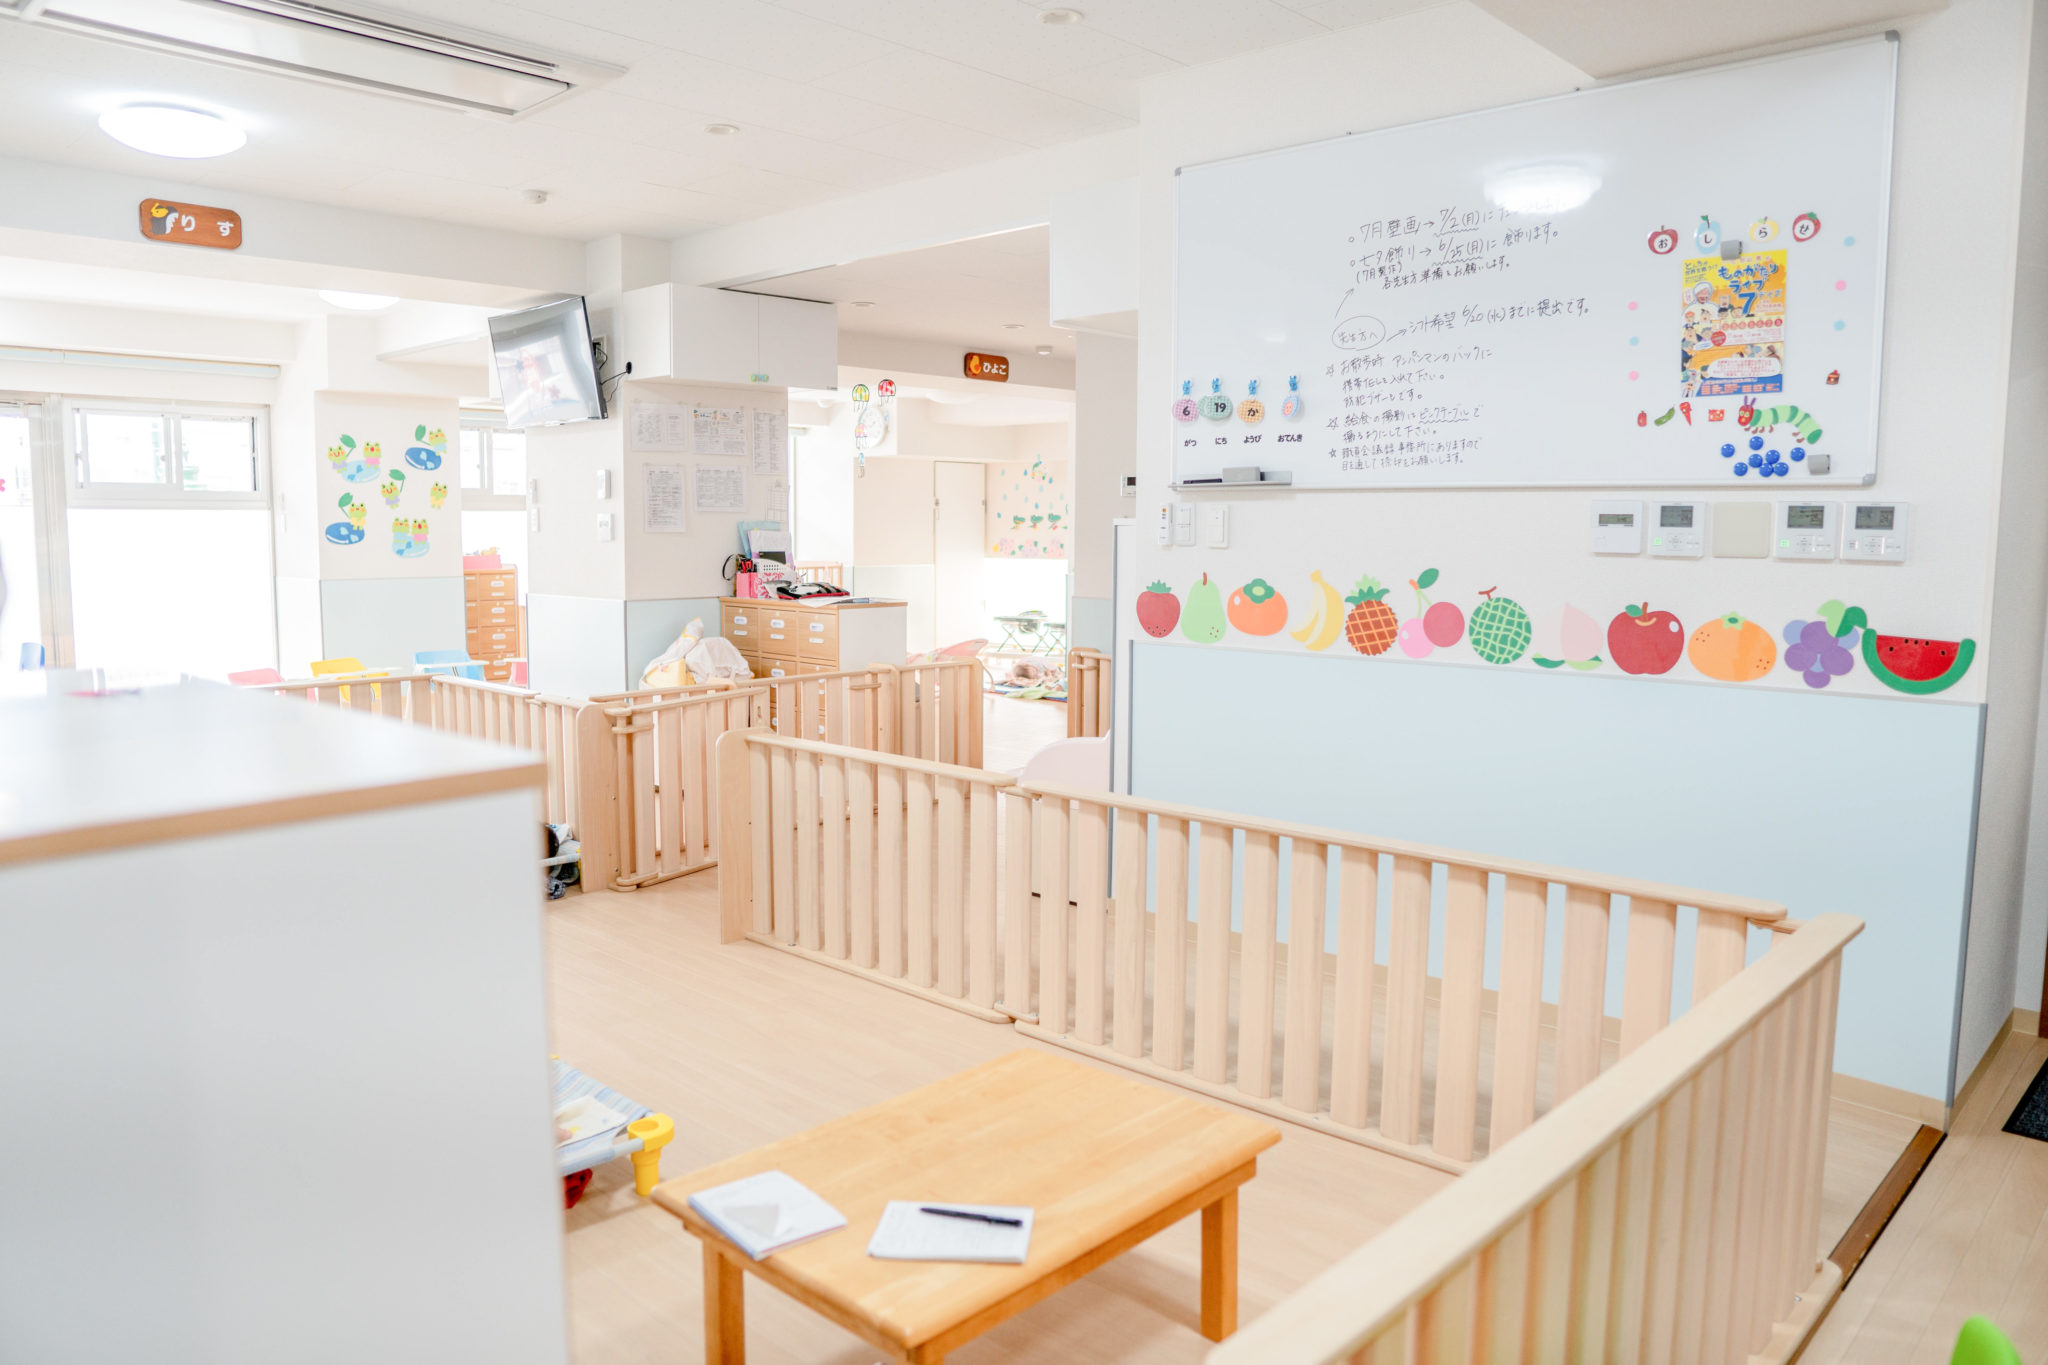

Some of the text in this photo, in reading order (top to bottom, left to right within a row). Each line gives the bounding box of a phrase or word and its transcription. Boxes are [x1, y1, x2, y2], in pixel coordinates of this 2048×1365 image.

[181, 214, 234, 237] りす
[1717, 262, 1779, 280] ものがたり
[1729, 276, 1769, 294] ライブ
[982, 361, 1008, 375] ひよこ
[1182, 402, 1259, 417] 6 19 か
[1184, 433, 1303, 447] がつ にち ようび おてんき
